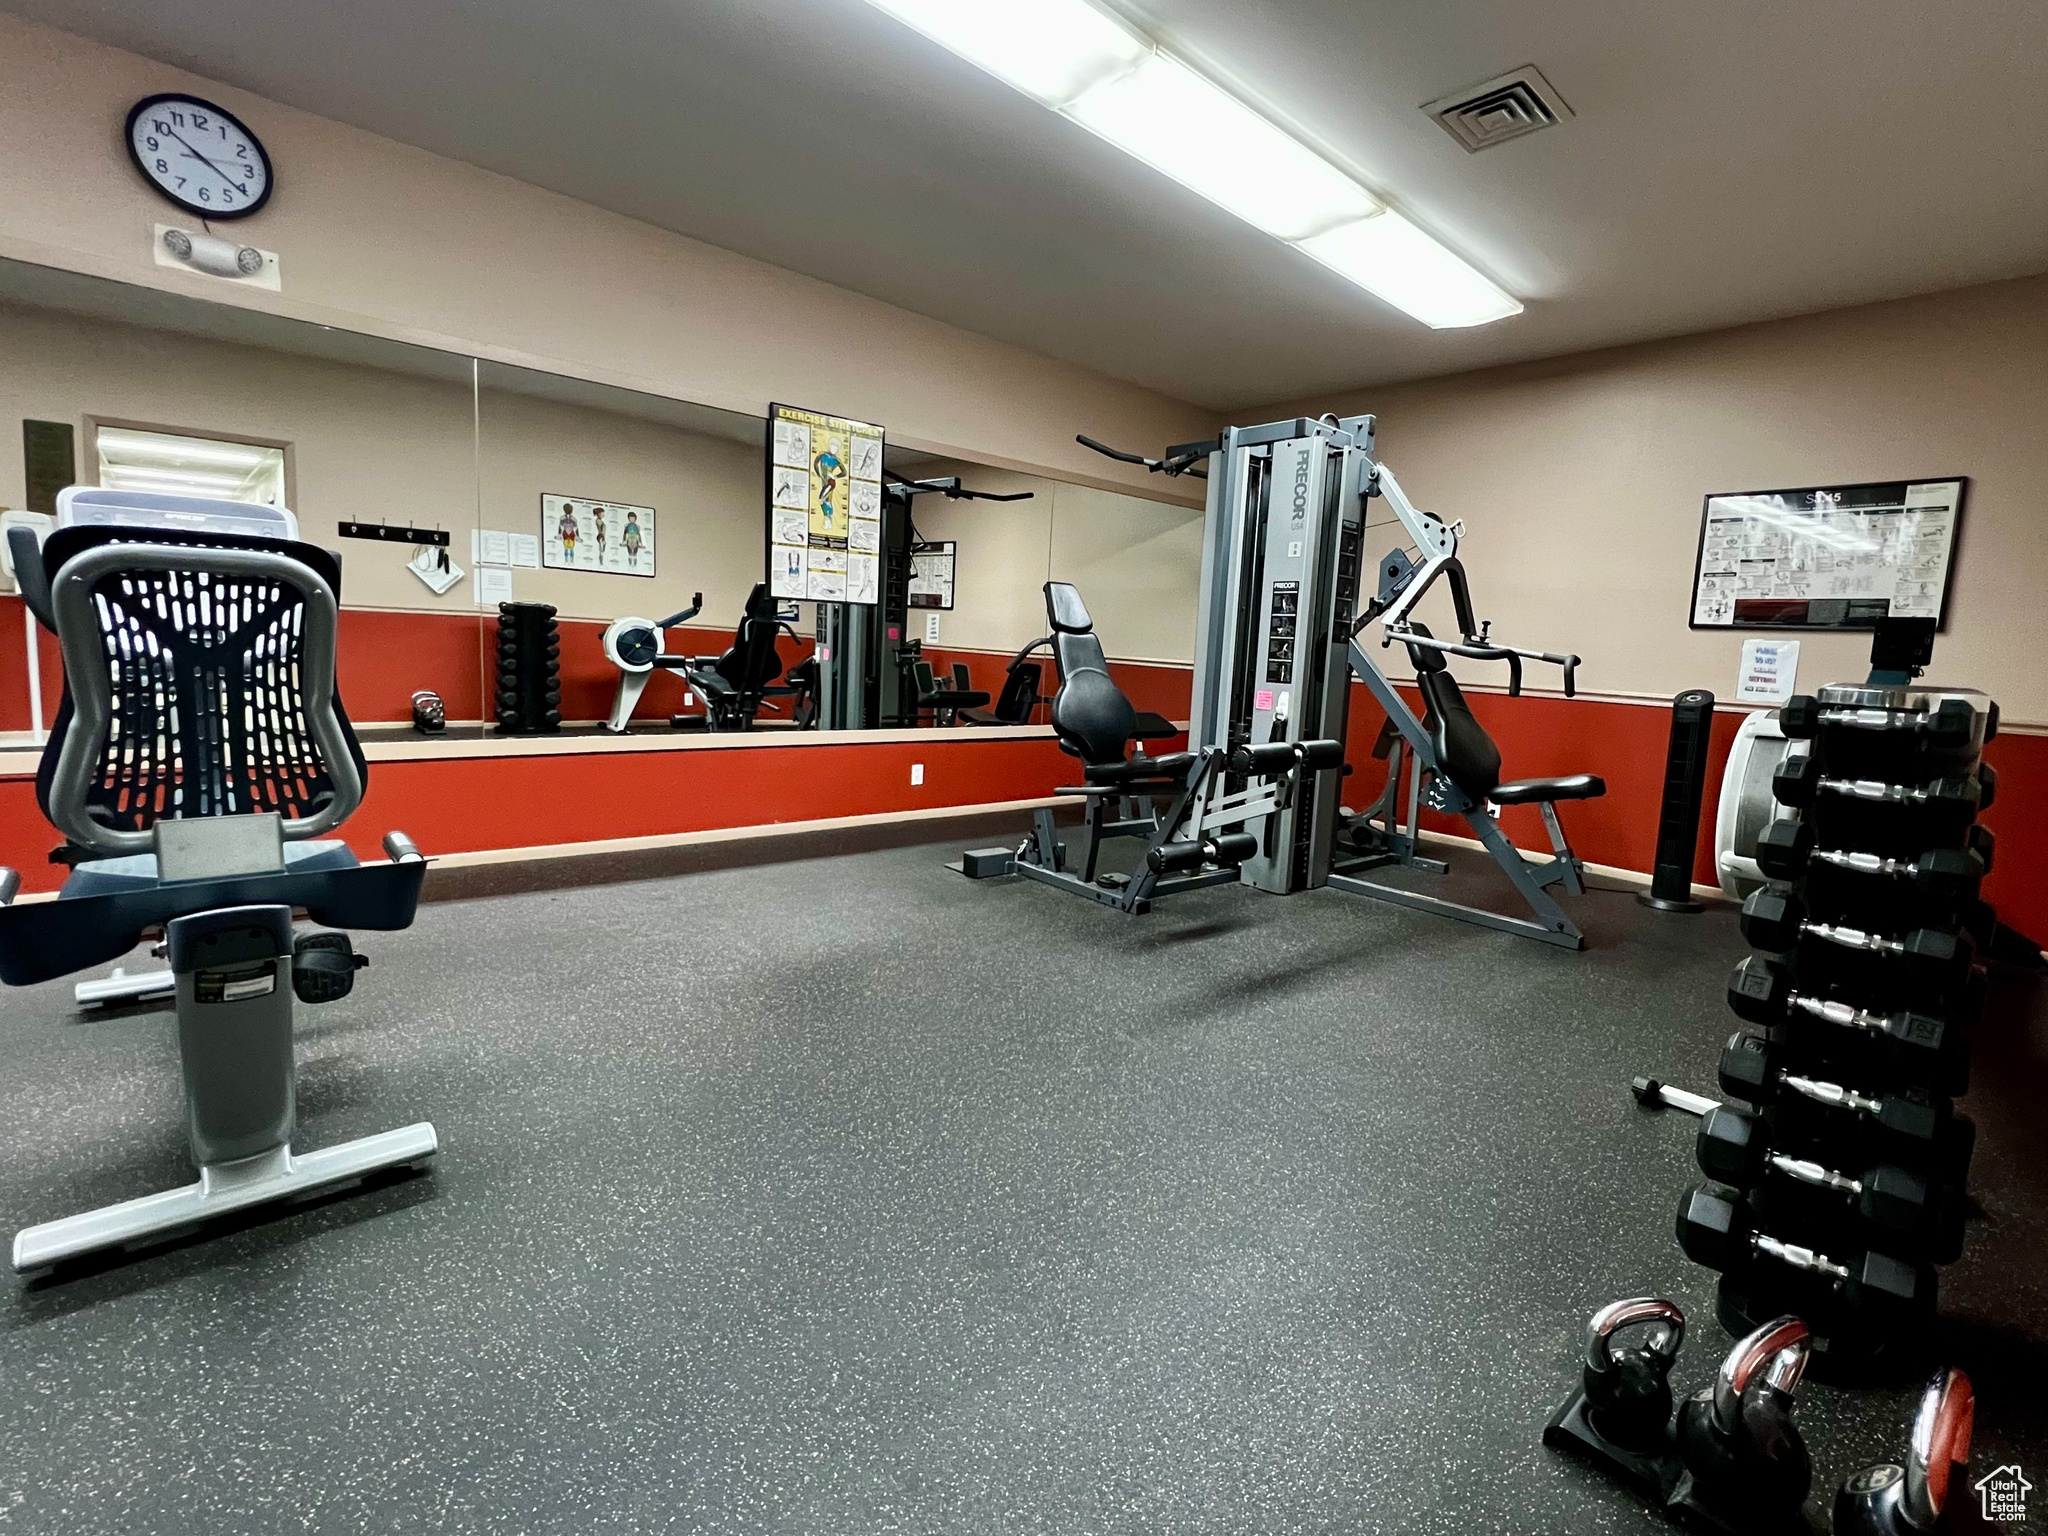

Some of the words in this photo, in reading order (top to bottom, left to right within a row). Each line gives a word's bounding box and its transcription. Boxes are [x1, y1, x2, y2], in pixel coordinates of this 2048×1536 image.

[170, 111, 184, 127] 11
[191, 113, 209, 131] 12
[152, 119, 171, 137] 10
[219, 126, 226, 140] 1
[146, 136, 159, 152] 9
[236, 144, 248, 159] 2
[156, 159, 168, 174] 8
[244, 164, 254, 179] 3
[174, 176, 187, 189] 7
[237, 182, 249, 197] 4
[198, 187, 210, 202] 6
[223, 188, 233, 203] 5
[779, 408, 826, 426] EXERCISE
[1292, 449, 1310, 520] PRECOR
